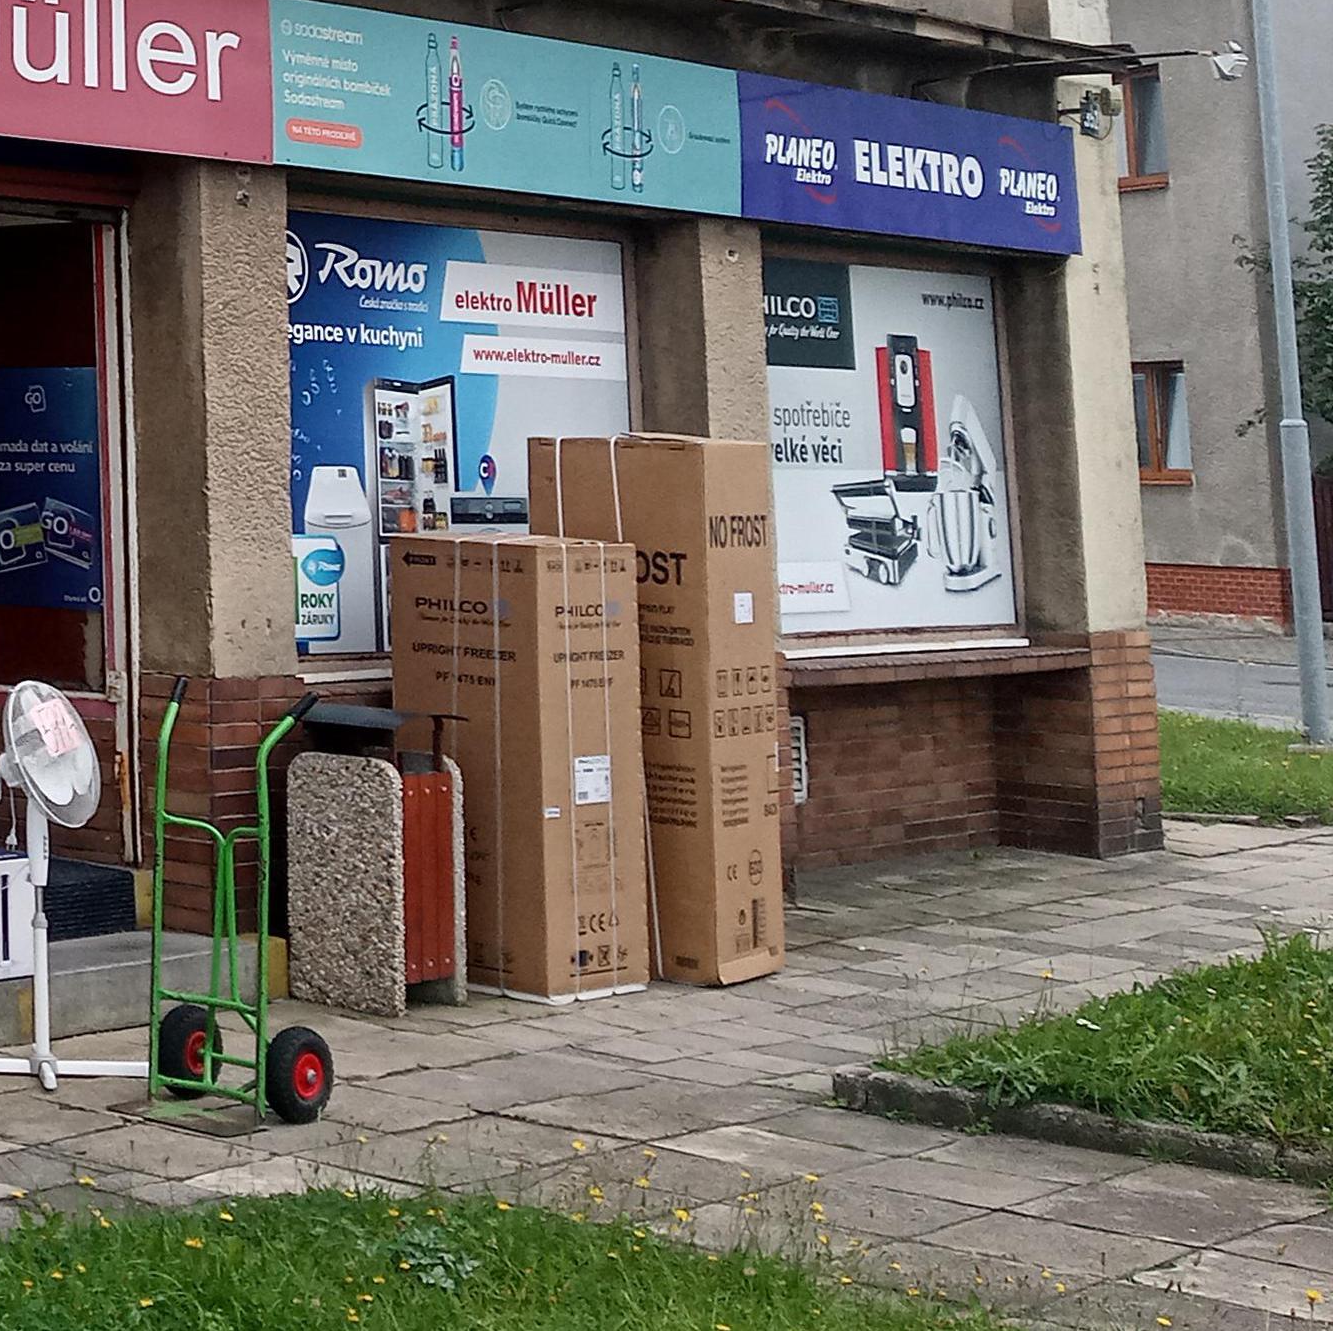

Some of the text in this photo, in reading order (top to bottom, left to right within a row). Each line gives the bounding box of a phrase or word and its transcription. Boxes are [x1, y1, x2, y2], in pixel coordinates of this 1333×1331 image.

[294, 22, 364, 46] sodastream
[765, 133, 837, 170] PLANEO
[796, 167, 833, 186] Elektro
[852, 138, 985, 200] ELEKTRO
[999, 166, 1059, 202] PLANEO
[1024, 200, 1056, 217] Elektro
[314, 241, 429, 294] Romo
[454, 280, 598, 319] elektro Müller
[764, 294, 817, 319] HILCO
[920, 291, 986, 311] www.philco.cz
[287, 322, 344, 346] egance
[345, 326, 357, 343] v
[472, 347, 602, 369] www.elektro-muller.cz
[773, 399, 851, 435] spotřebiče
[31, 439, 49, 454] dat
[50, 443, 58, 454] a
[811, 435, 843, 465] věci
[0, 461, 77, 475] za super cenu
[41, 511, 69, 536] GO
[709, 514, 768, 549] NO FROST
[636, 549, 688, 587] OST
[300, 593, 335, 610] ROKY
[415, 596, 488, 615] PHILCO
[463, 648, 517, 663] FREEER
